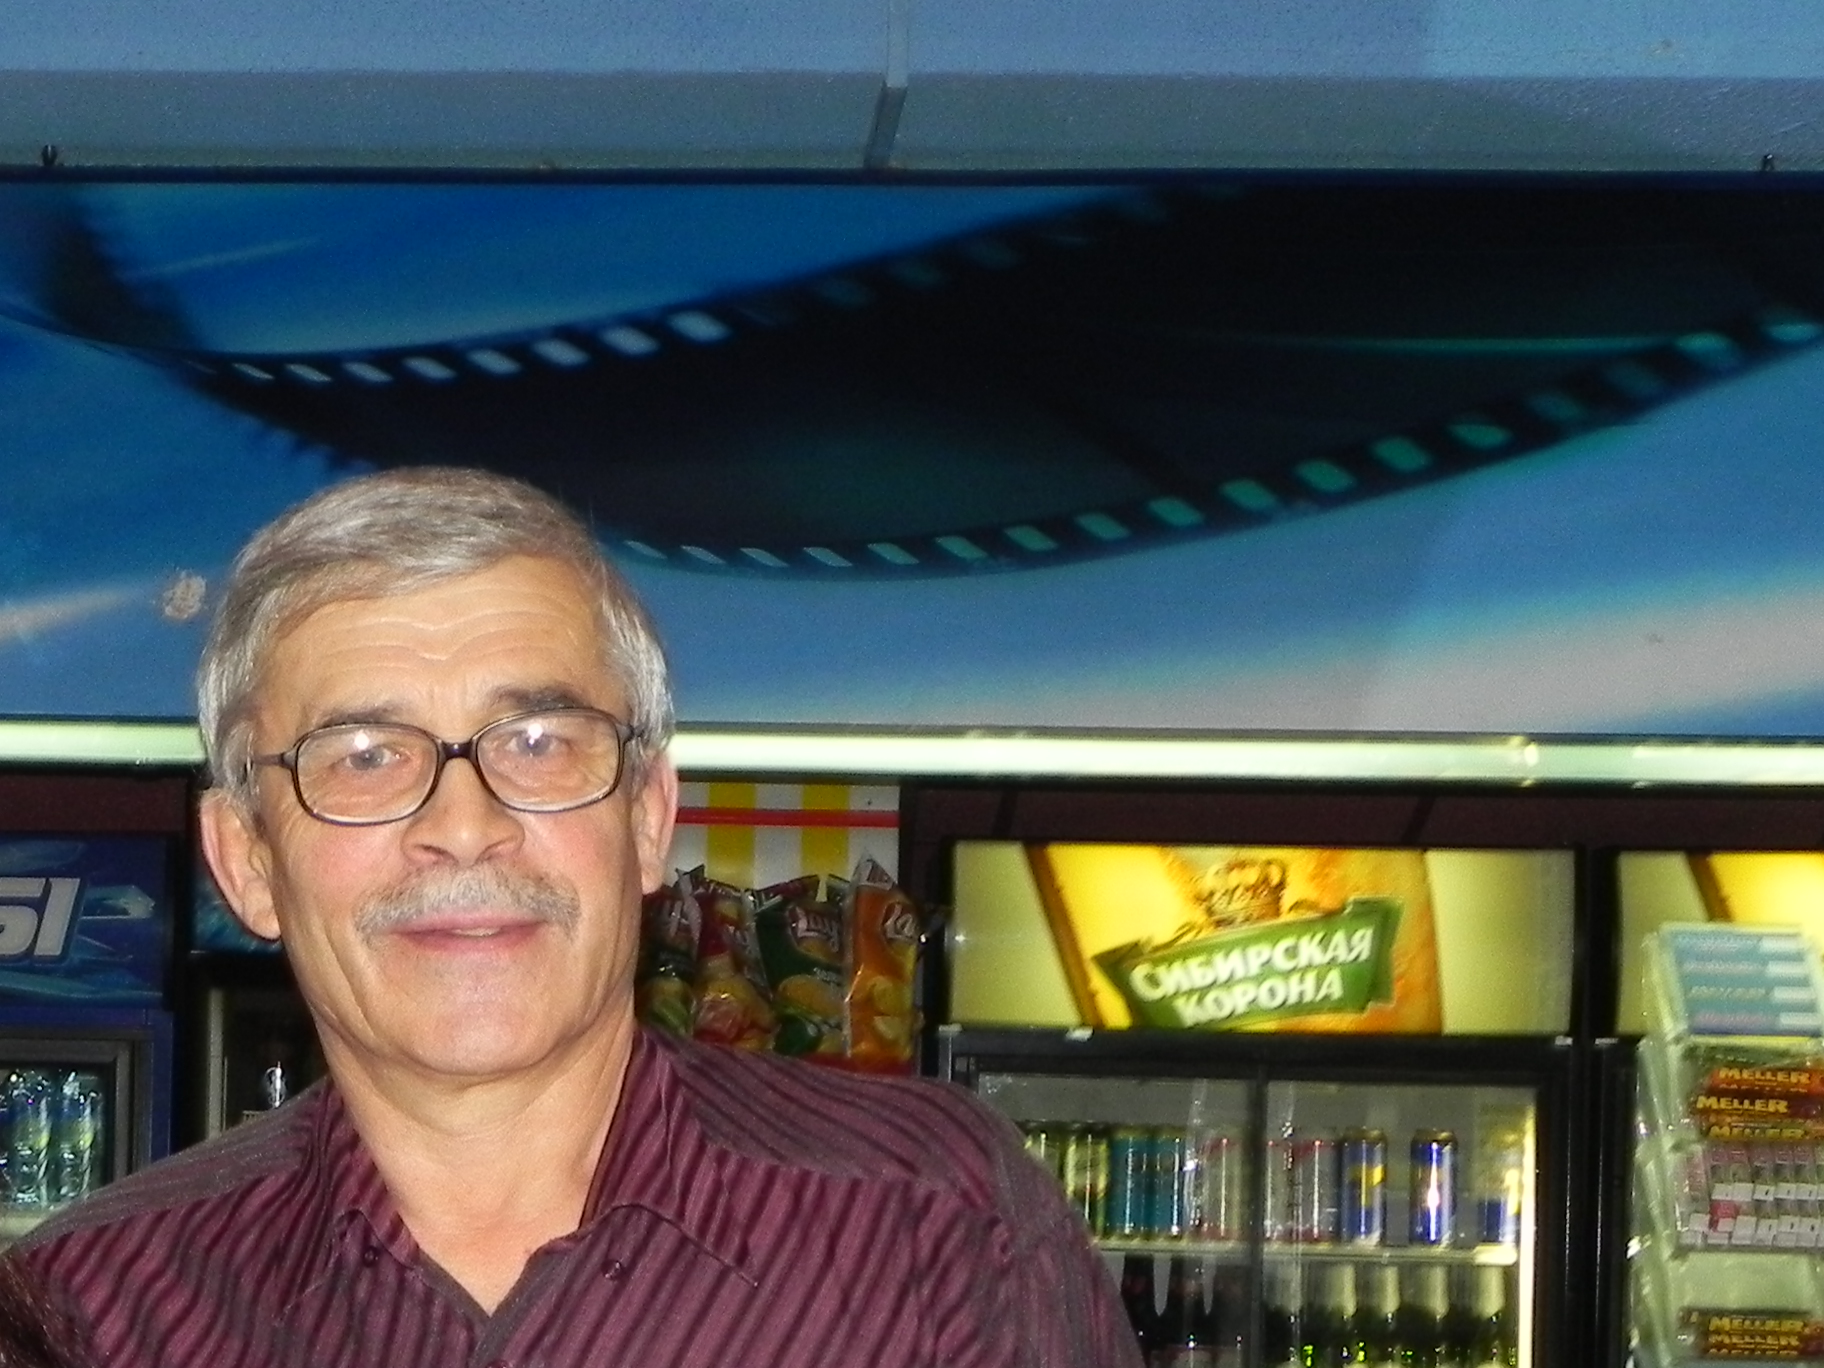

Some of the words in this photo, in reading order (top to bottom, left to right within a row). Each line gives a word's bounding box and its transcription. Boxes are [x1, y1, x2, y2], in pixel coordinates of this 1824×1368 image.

[1129, 926, 1375, 1001] СИБИРСКАЯ
[1171, 968, 1344, 1027] КОРОНА
[1696, 1095, 1788, 1113] MELLER
